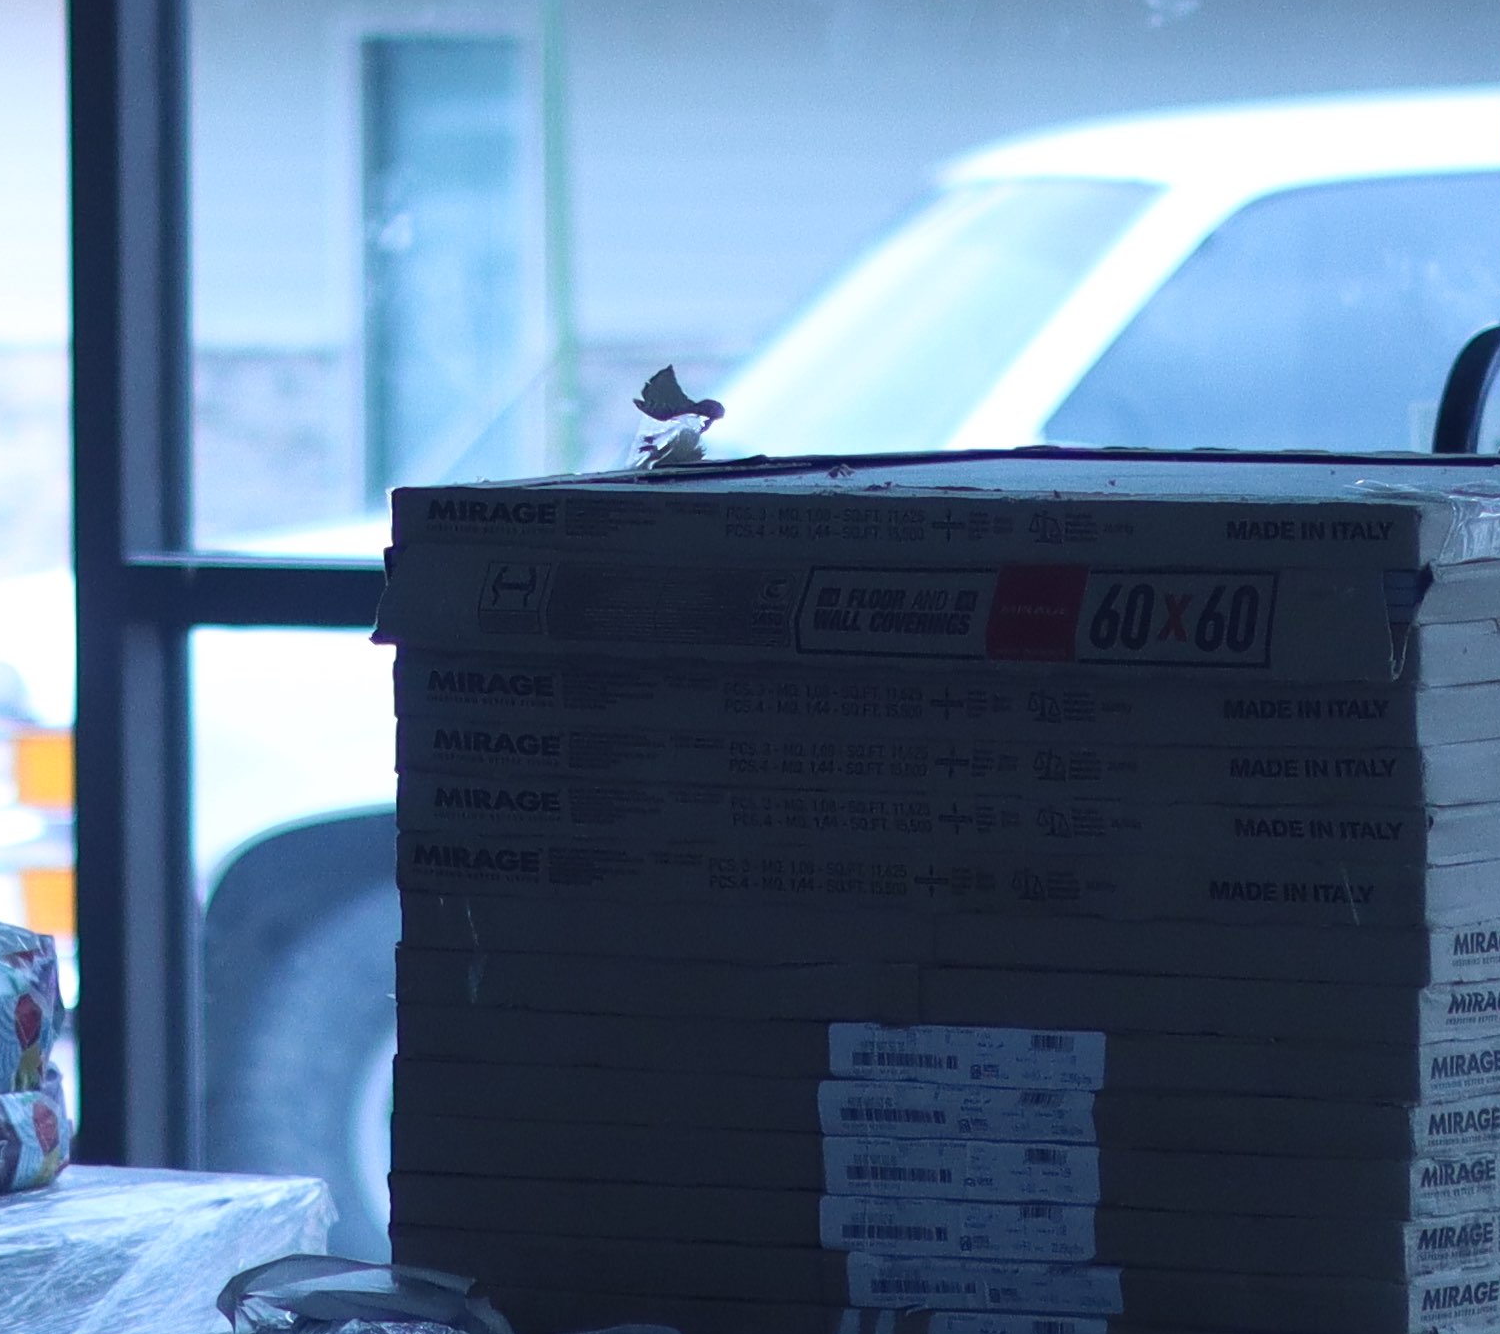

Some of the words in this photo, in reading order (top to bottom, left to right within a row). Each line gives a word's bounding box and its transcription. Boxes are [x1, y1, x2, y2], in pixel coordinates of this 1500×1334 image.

[428, 498, 557, 525] MIRAGE
[1226, 520, 1295, 540] MADE
[1301, 521, 1328, 540] IN
[1331, 521, 1394, 541] ITALY
[847, 588, 906, 609] FLOOR
[911, 590, 949, 610] AND
[813, 610, 862, 633] WALL
[869, 611, 971, 636] COVERINGS
[427, 670, 554, 697] MIRAGE
[1222, 699, 1294, 719] MADE
[1299, 700, 1323, 719] IN
[1327, 700, 1389, 720] ITALY
[434, 729, 560, 756] MIRAGE
[1229, 758, 1300, 778] MADE
[1305, 759, 1328, 778] IN
[1333, 758, 1396, 778] ITALY
[434, 787, 562, 813] MIRAGE
[1234, 818, 1304, 838] MADE
[1309, 819, 1333, 839] IN
[1339, 820, 1403, 840] ITALY
[413, 844, 540, 873] MIRAGE
[1208, 880, 1277, 902] MADE
[1283, 881, 1307, 903] IN
[1312, 882, 1375, 905] ITALY
[1428, 1108, 1500, 1136] MIRAGE
[1420, 1159, 1496, 1188] MIRAGE
[1418, 1223, 1493, 1250] MIRAGE
[1421, 1280, 1500, 1310] MIRAGE
